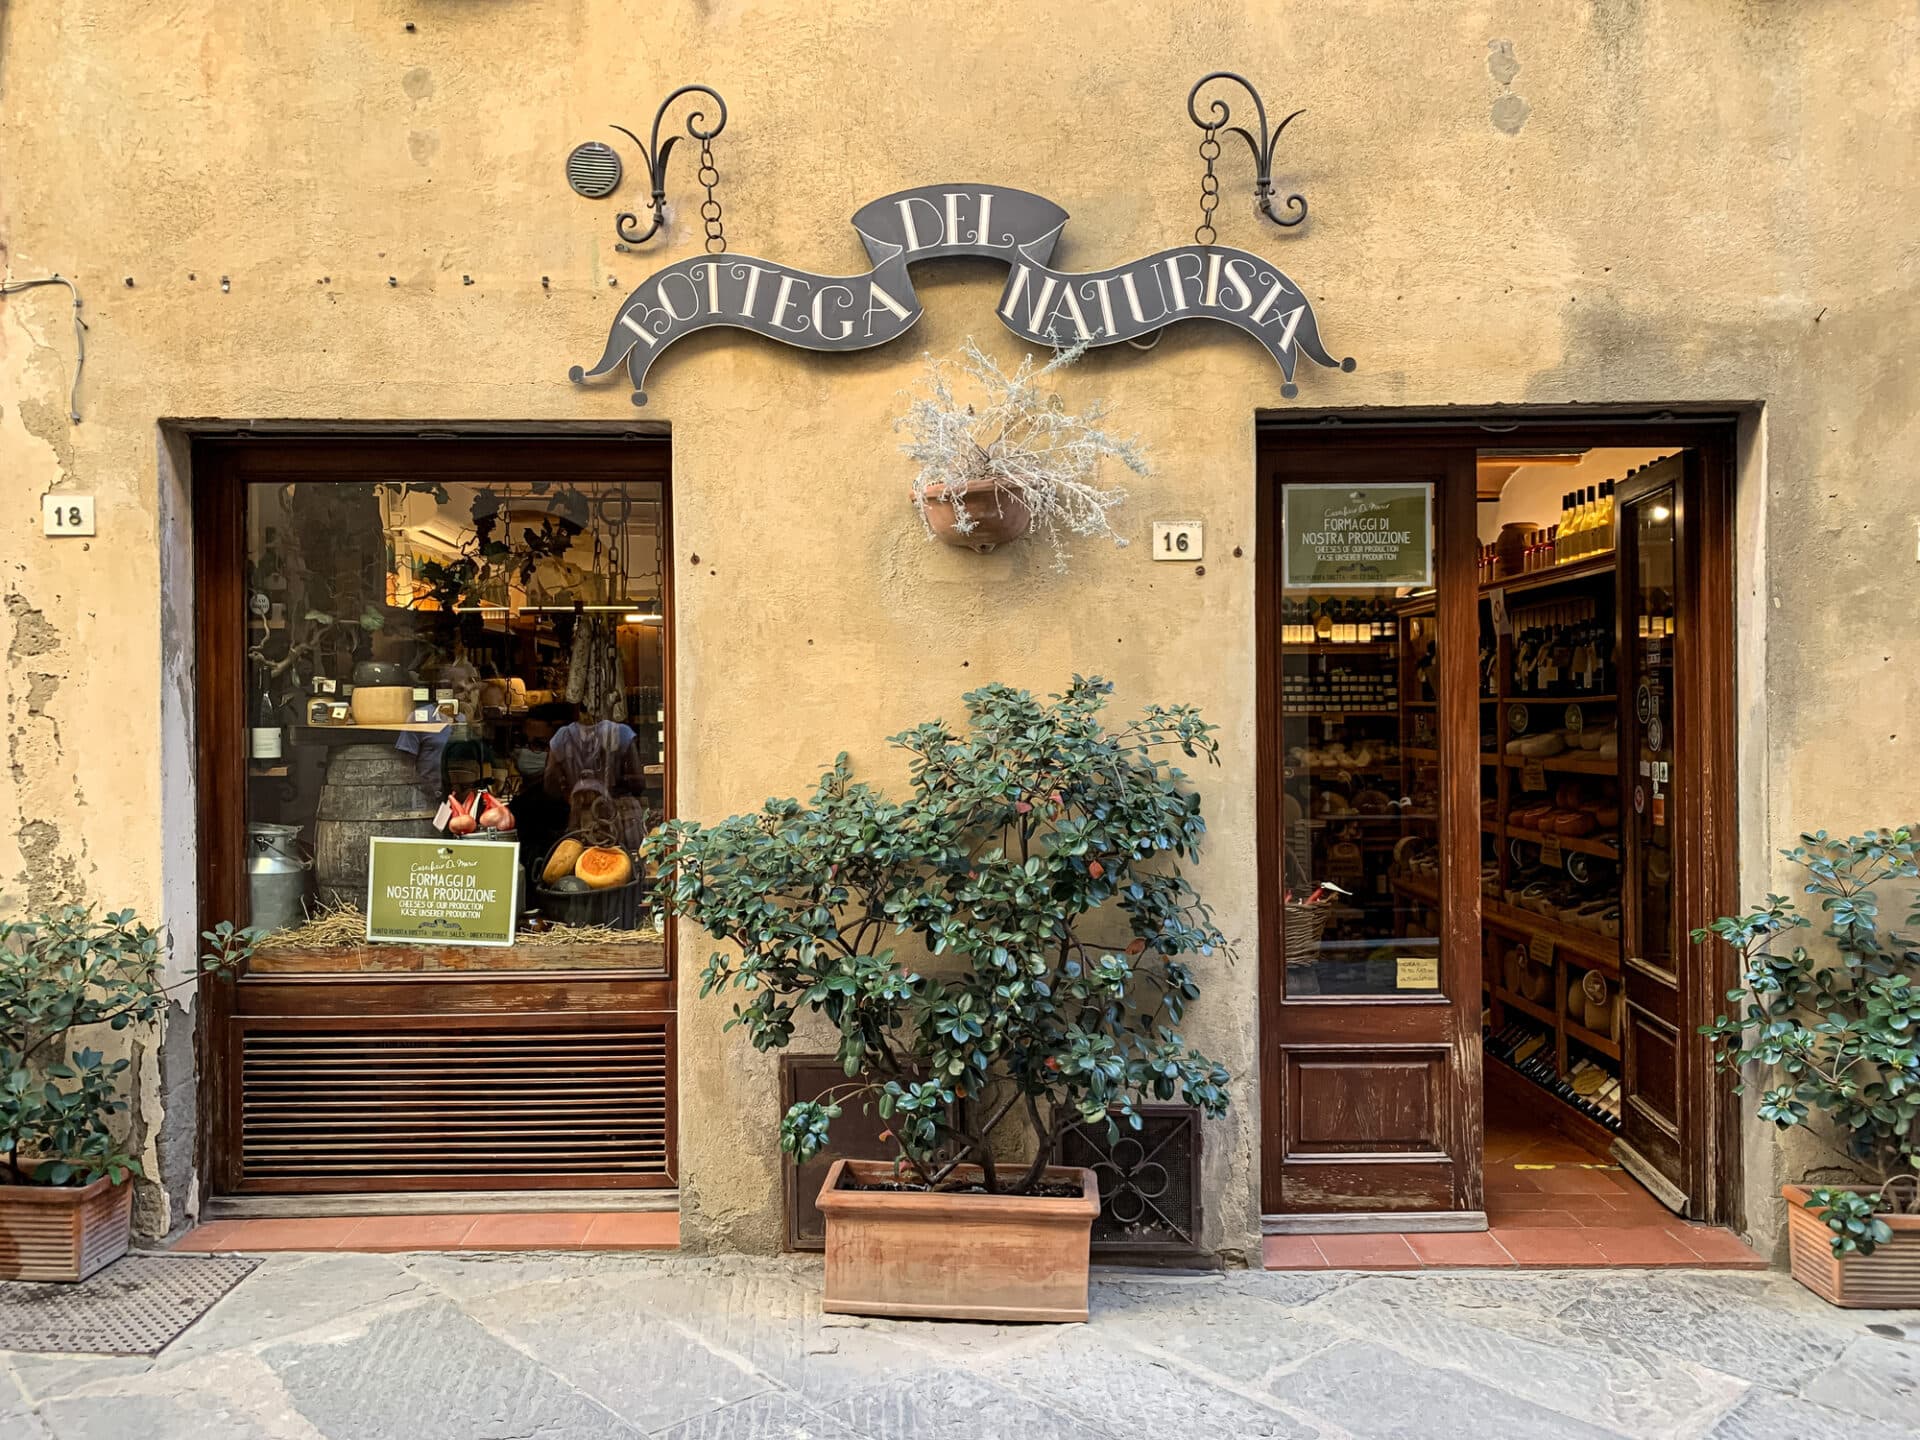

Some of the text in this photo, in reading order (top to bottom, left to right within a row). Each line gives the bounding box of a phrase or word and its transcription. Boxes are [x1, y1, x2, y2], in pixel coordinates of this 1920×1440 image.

[619, 193, 1307, 353] BOTTEGA DEL NATURISTA
[54, 506, 83, 527] 18
[1324, 517, 1390, 531] FORMAGGI DI
[1163, 531, 1189, 552] 16
[1302, 531, 1411, 545] NOSTRA PRODUZIONE
[1314, 545, 1342, 553] CHEESES
[1351, 545, 1363, 553] OUR
[1364, 545, 1400, 553] PRODUCTION
[410, 873, 476, 888] FORMAGGI DI
[386, 886, 497, 903] NOSTRA PRODUZIONE
[399, 900, 484, 911] CHEESES OF OUR PRODUCTION
[445, 910, 481, 919] PRODUKTION
